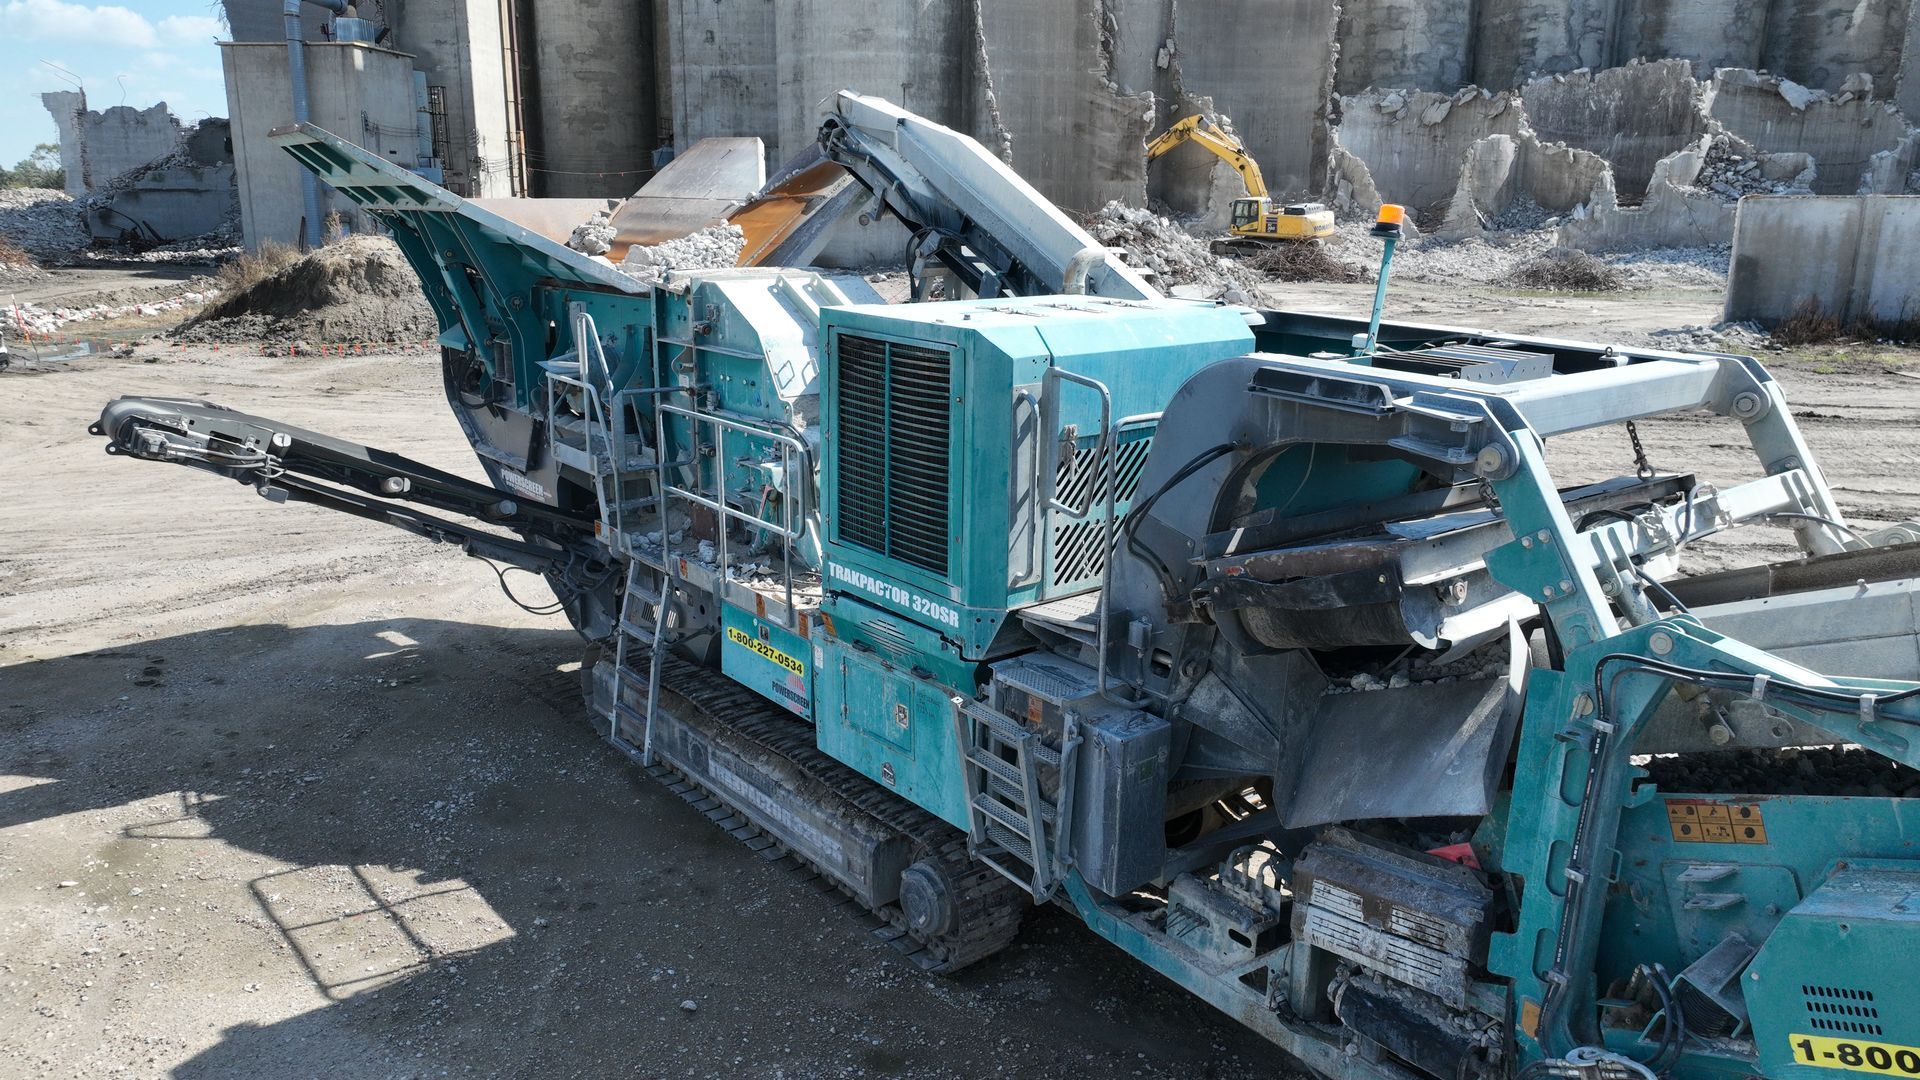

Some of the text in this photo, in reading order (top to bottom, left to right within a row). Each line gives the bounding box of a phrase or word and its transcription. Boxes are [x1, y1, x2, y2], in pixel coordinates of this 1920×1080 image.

[501, 469, 544, 497] POWERSCREEN
[828, 561, 960, 628] TRAKPACTOR 320SR
[728, 628, 803, 674] 1-800-227-0534
[771, 681, 810, 710] POWERSCREEN
[1797, 1039, 1920, 1074] 1-800
